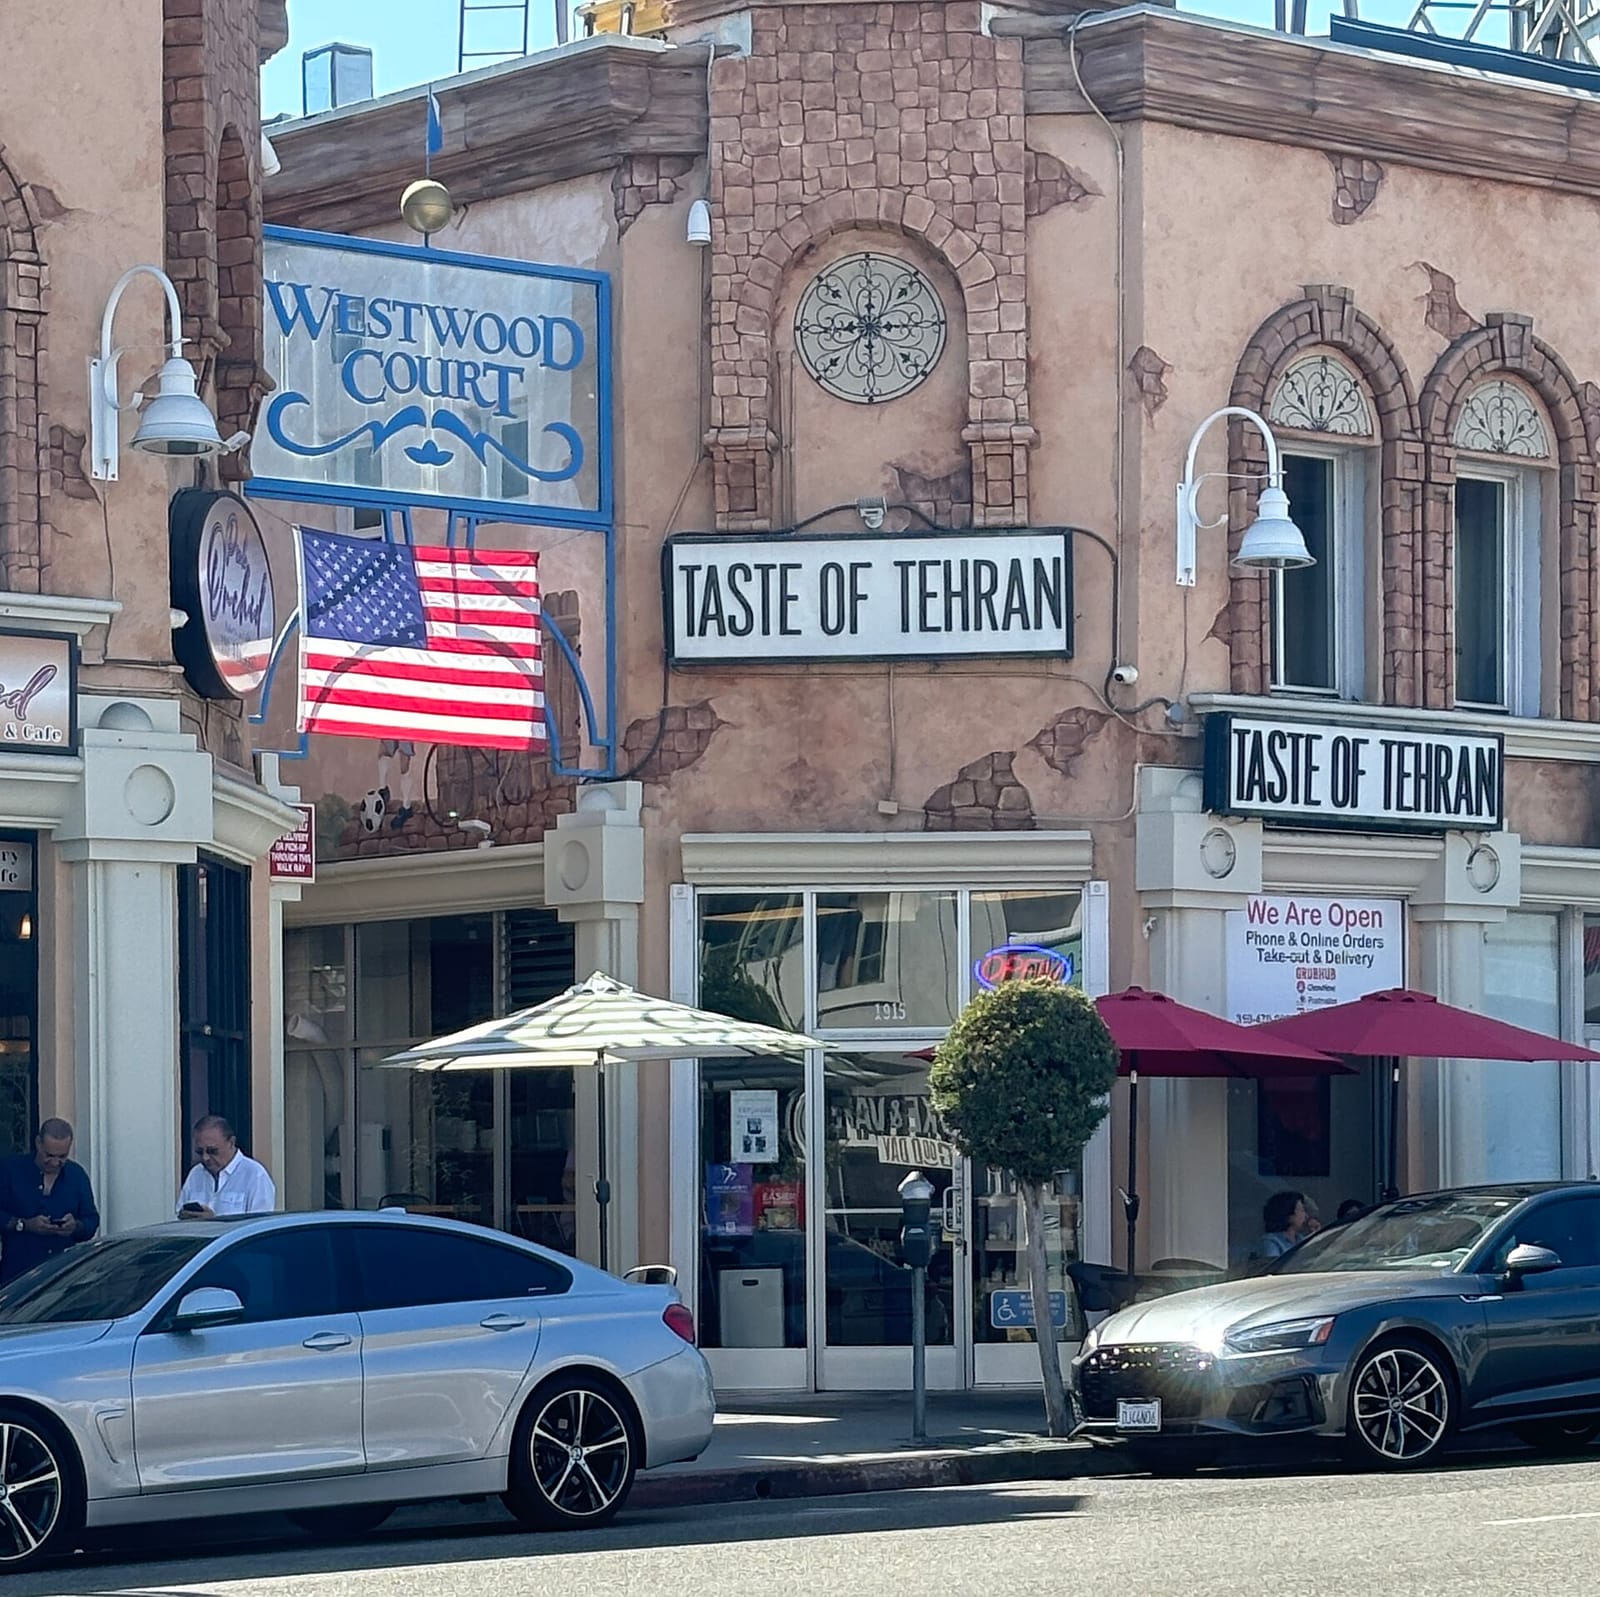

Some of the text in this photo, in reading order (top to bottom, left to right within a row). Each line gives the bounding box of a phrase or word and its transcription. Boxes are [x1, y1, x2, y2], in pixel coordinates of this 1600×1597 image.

[264, 279, 584, 371] WESTWOOD
[341, 349, 524, 418] COURT
[678, 557, 1063, 637] TASTE OF TEHRAN
[5, 723, 62, 741] & Cafe
[1232, 727, 1497, 817] TASTE OF TEHRAN
[1247, 899, 1383, 932] We Are Open
[1246, 931, 1384, 949] Phone & Online Orders
[1312, 950, 1322, 963] &
[1325, 950, 1374, 968] Delivery
[874, 1003, 906, 1020] 1915
